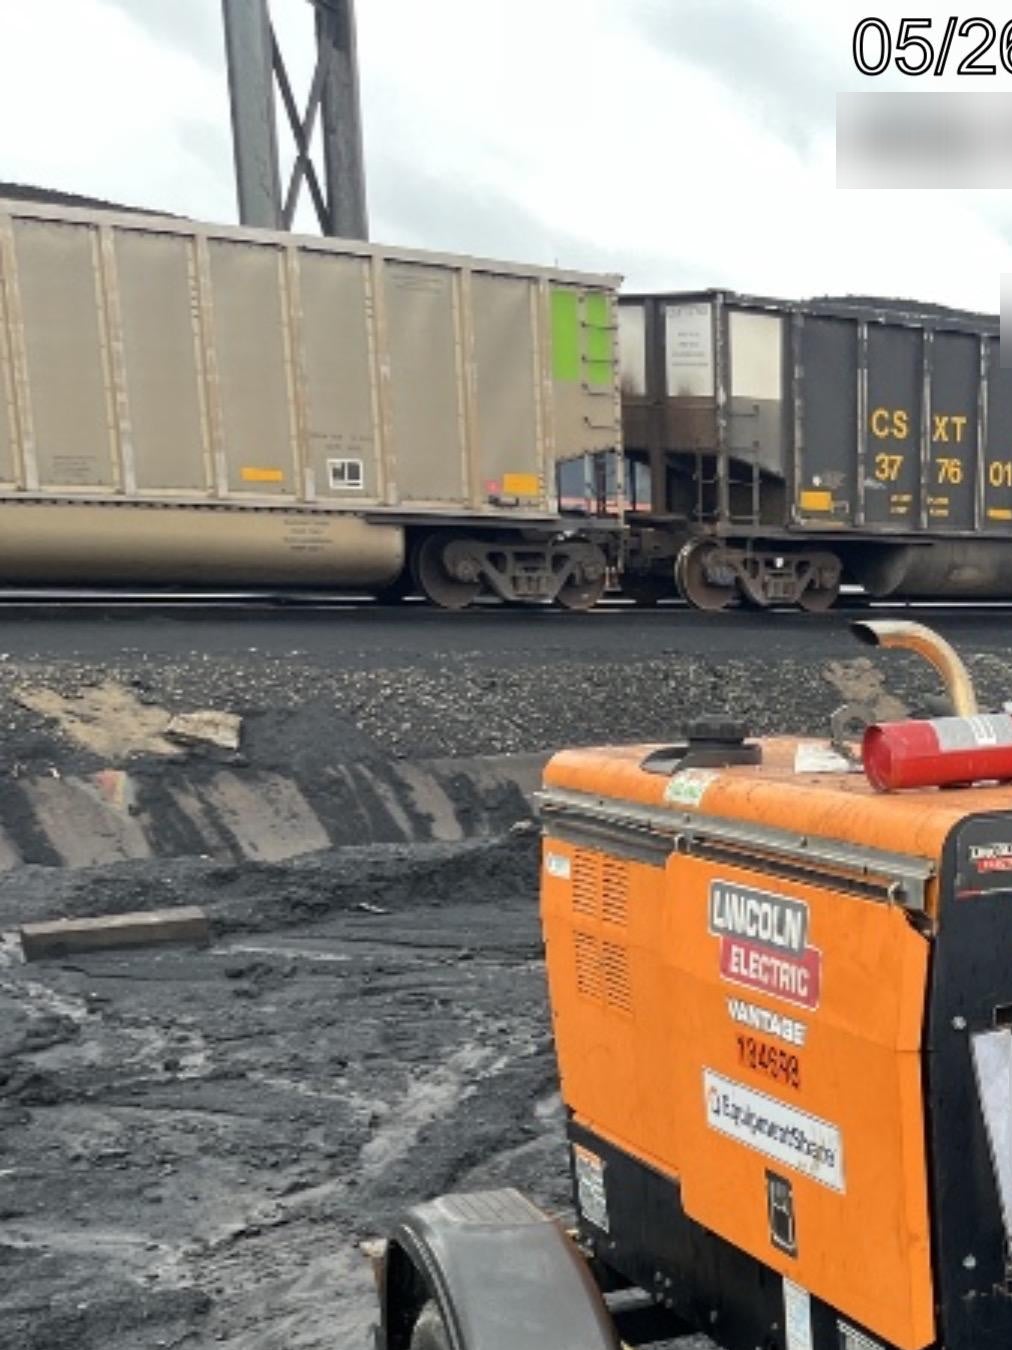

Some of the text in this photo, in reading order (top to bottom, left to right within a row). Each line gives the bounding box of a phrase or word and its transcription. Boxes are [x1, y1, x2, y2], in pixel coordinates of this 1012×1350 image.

[713, 889, 802, 951] LINCOLN
[729, 944, 810, 997] ELECTRIC
[727, 996, 808, 1048] VANTAGE
